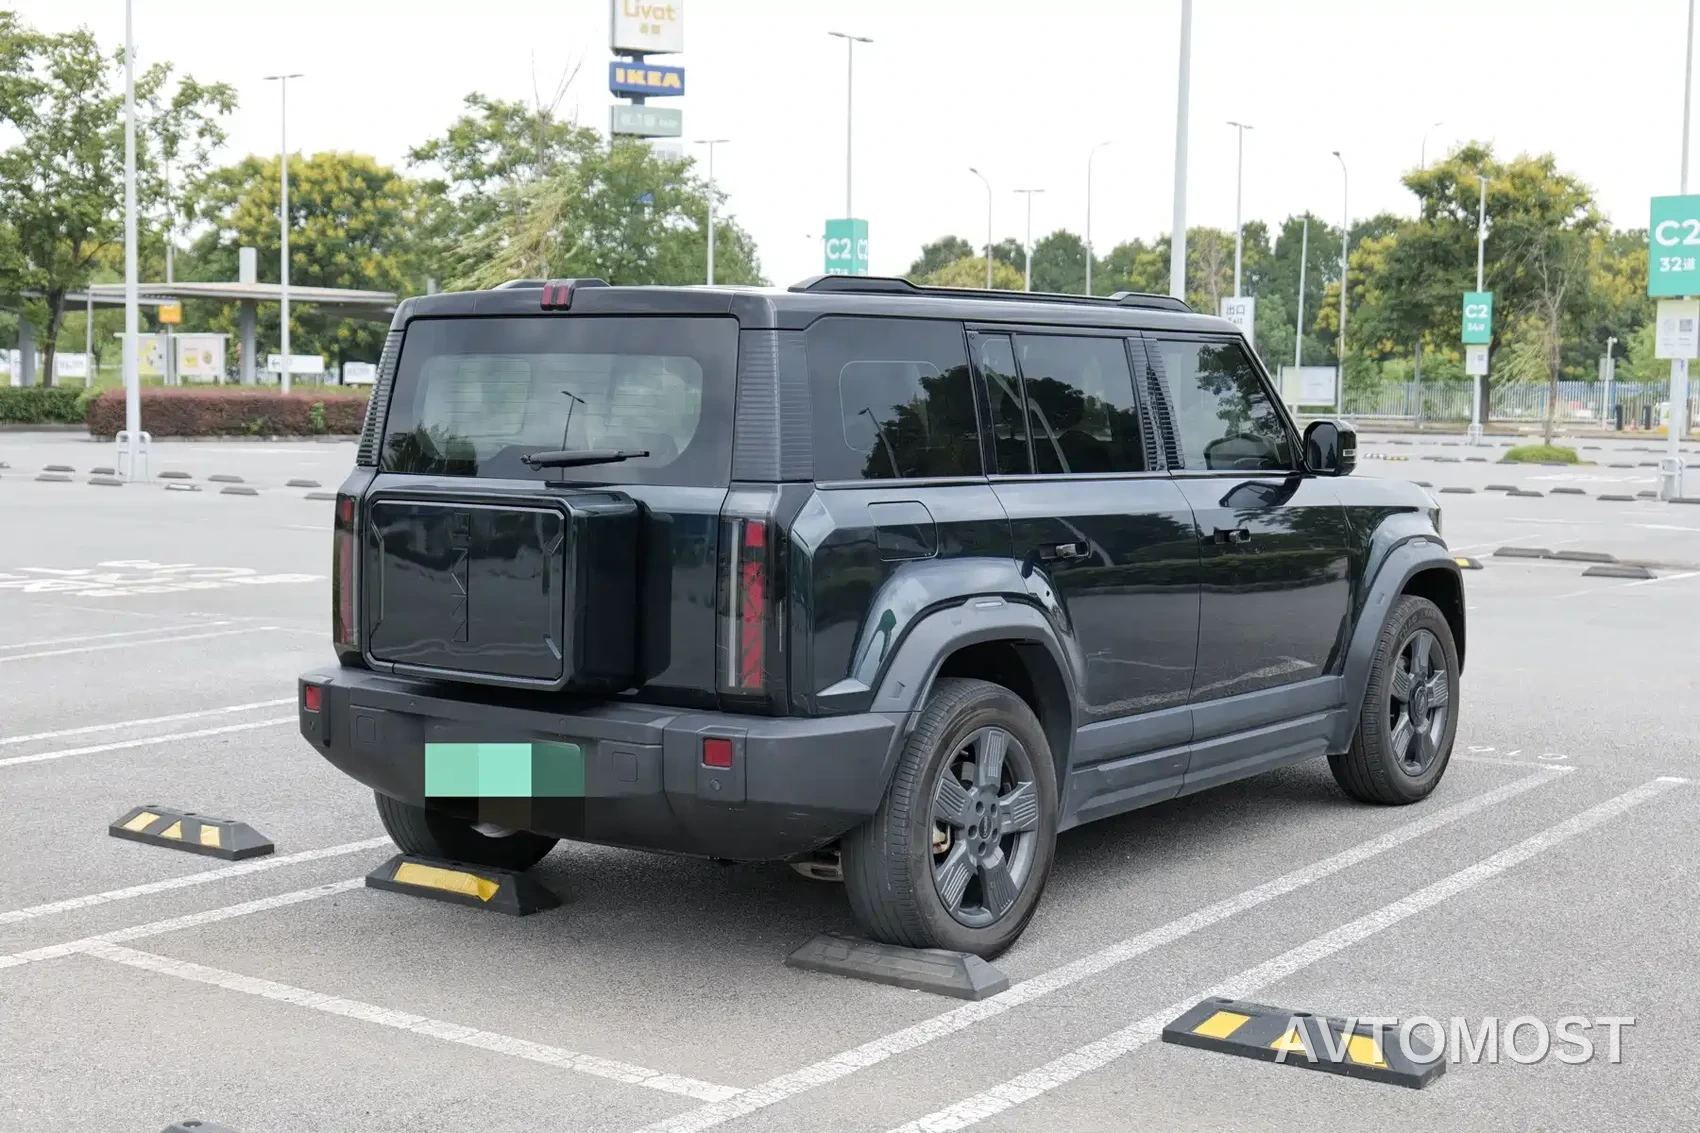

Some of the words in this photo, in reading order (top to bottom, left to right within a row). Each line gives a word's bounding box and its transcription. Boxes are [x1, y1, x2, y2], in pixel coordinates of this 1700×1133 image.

[615, 67, 682, 89] IKEA
[1655, 218, 1700, 247] C2
[826, 237, 852, 260] C2
[1226, 304, 1246, 316] 出口
[1465, 303, 1489, 319] C2
